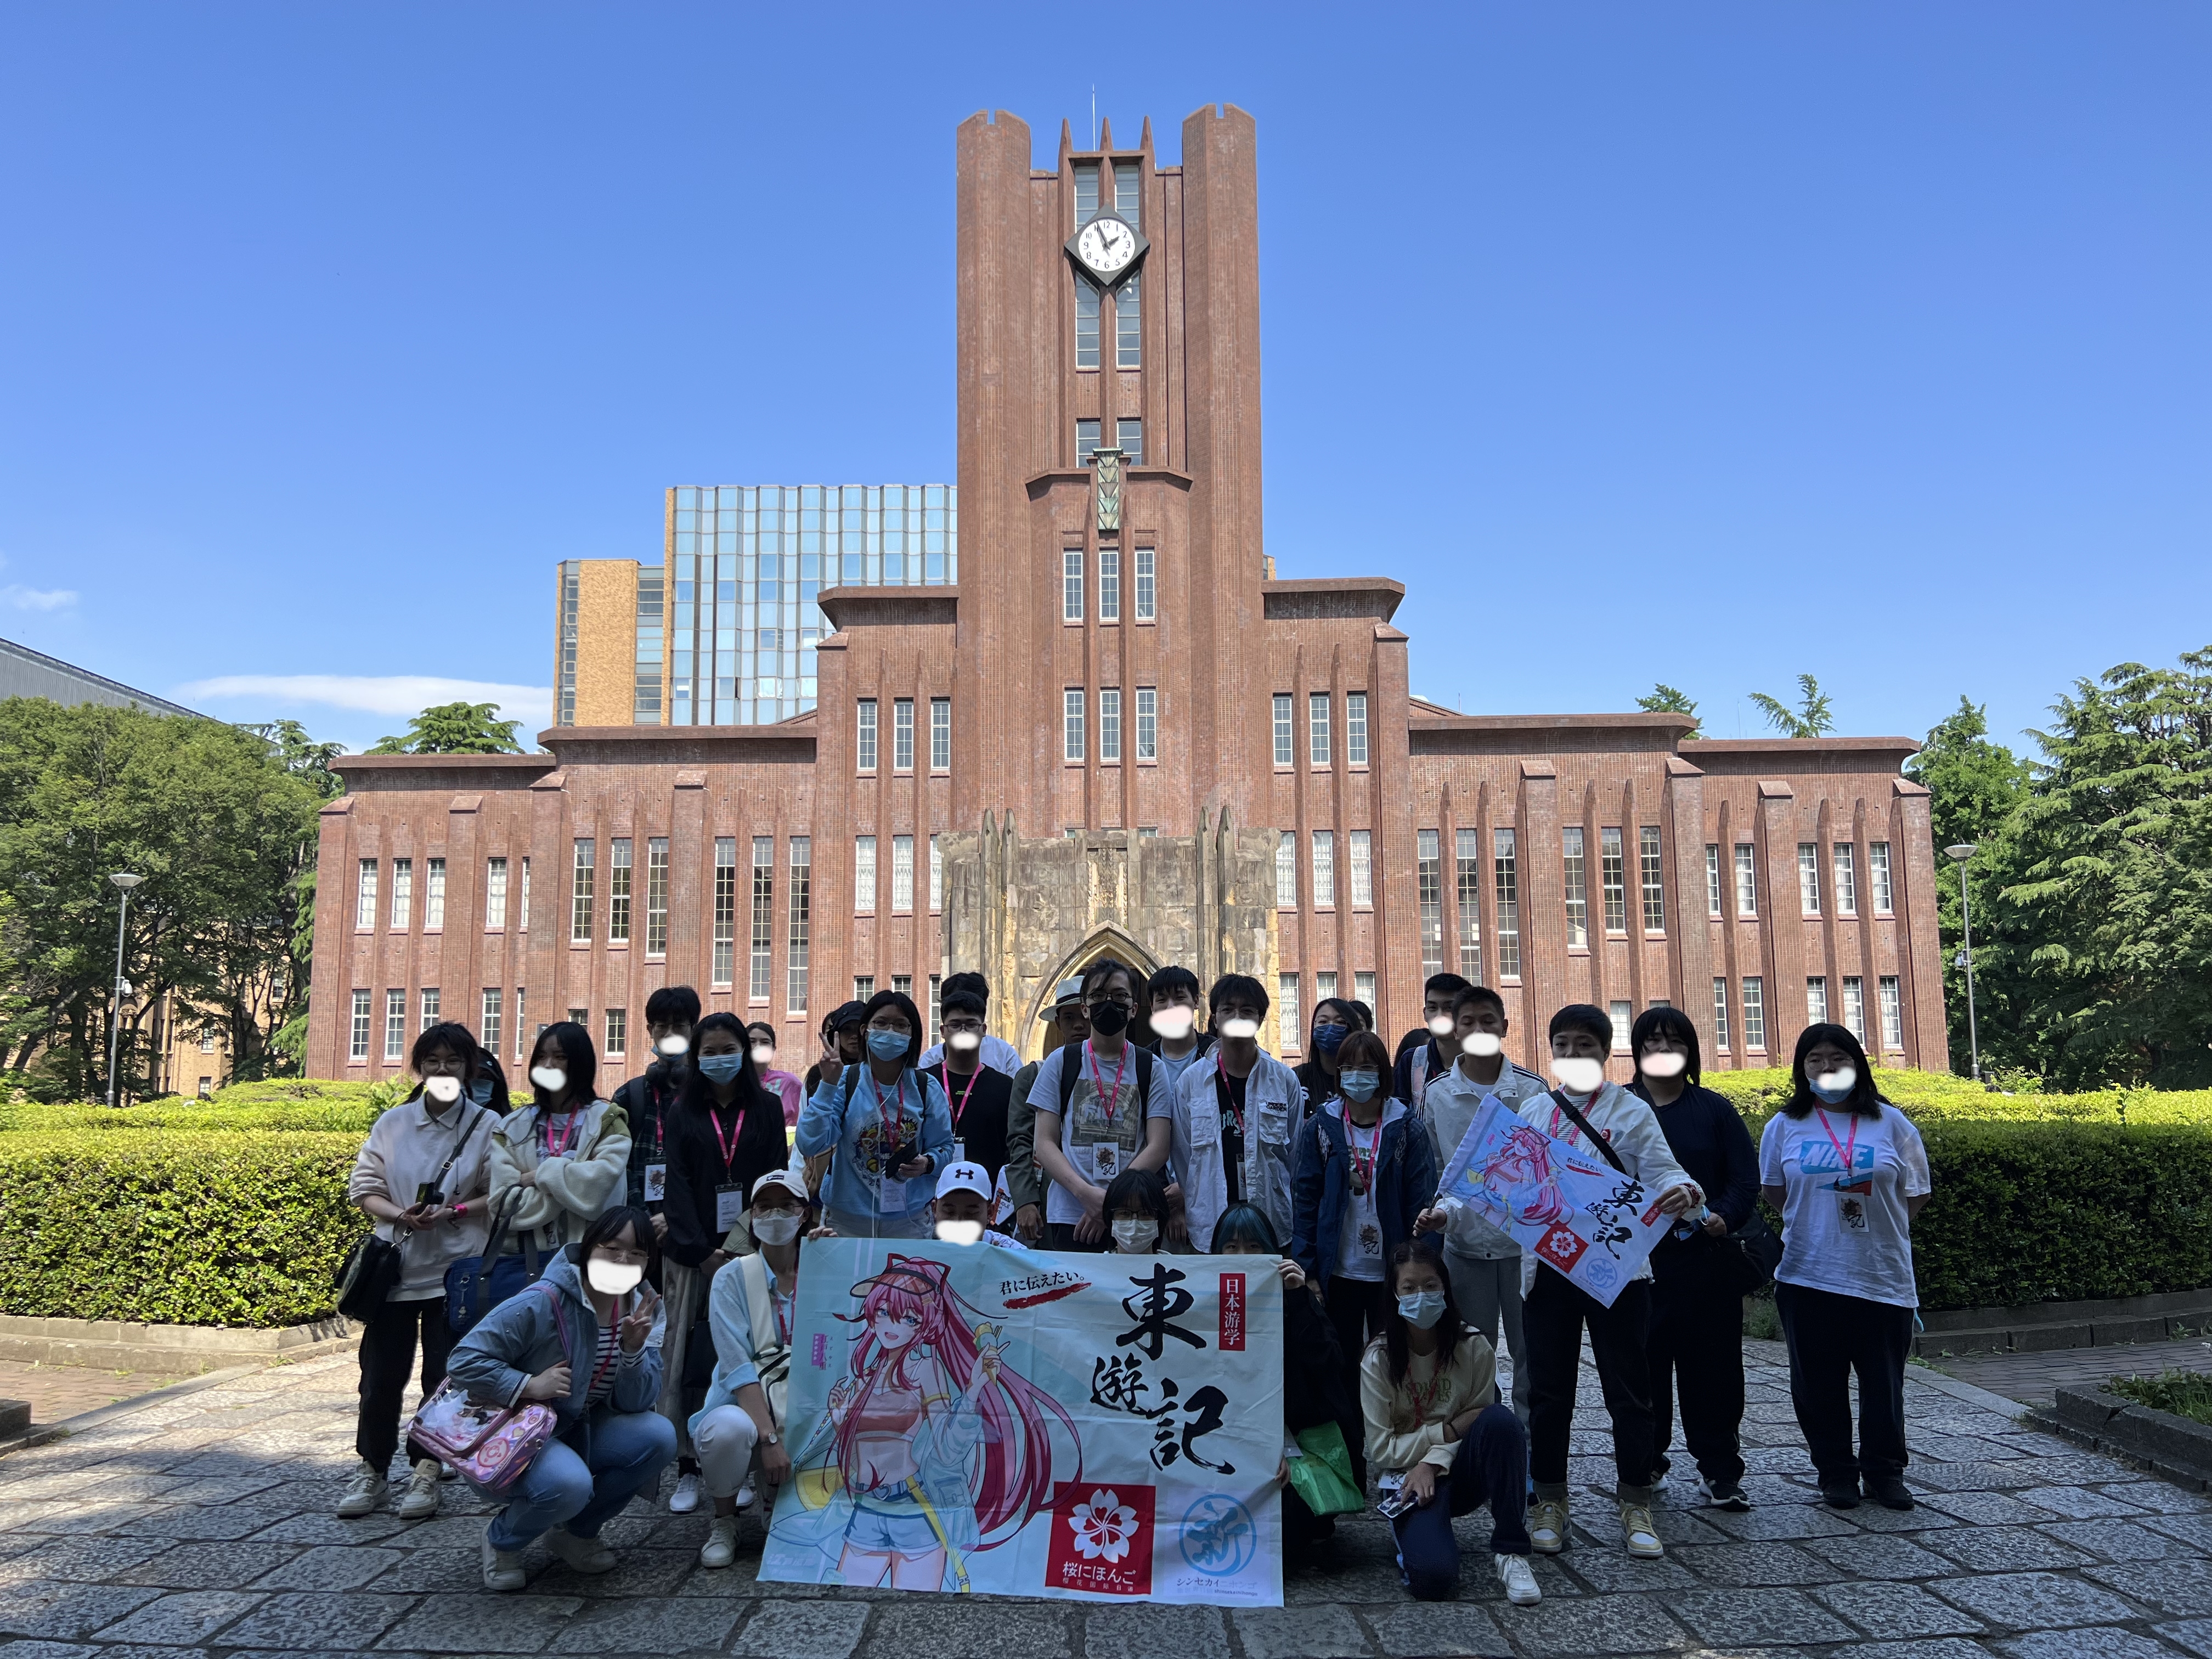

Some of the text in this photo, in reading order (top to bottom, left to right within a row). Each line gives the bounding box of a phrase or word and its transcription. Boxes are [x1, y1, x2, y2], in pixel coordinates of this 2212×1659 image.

[1103, 221, 1110, 229] 12
[1116, 223, 1119, 232] 1
[1125, 240, 1131, 249] 3
[1104, 261, 1110, 269] 6
[1802, 1143, 1869, 1170] NIKE
[999, 1272, 1085, 1295] 君に伝えたい。
[1224, 1278, 1241, 1346] 日本游学
[1062, 1561, 1137, 1585] 桜にほんご
